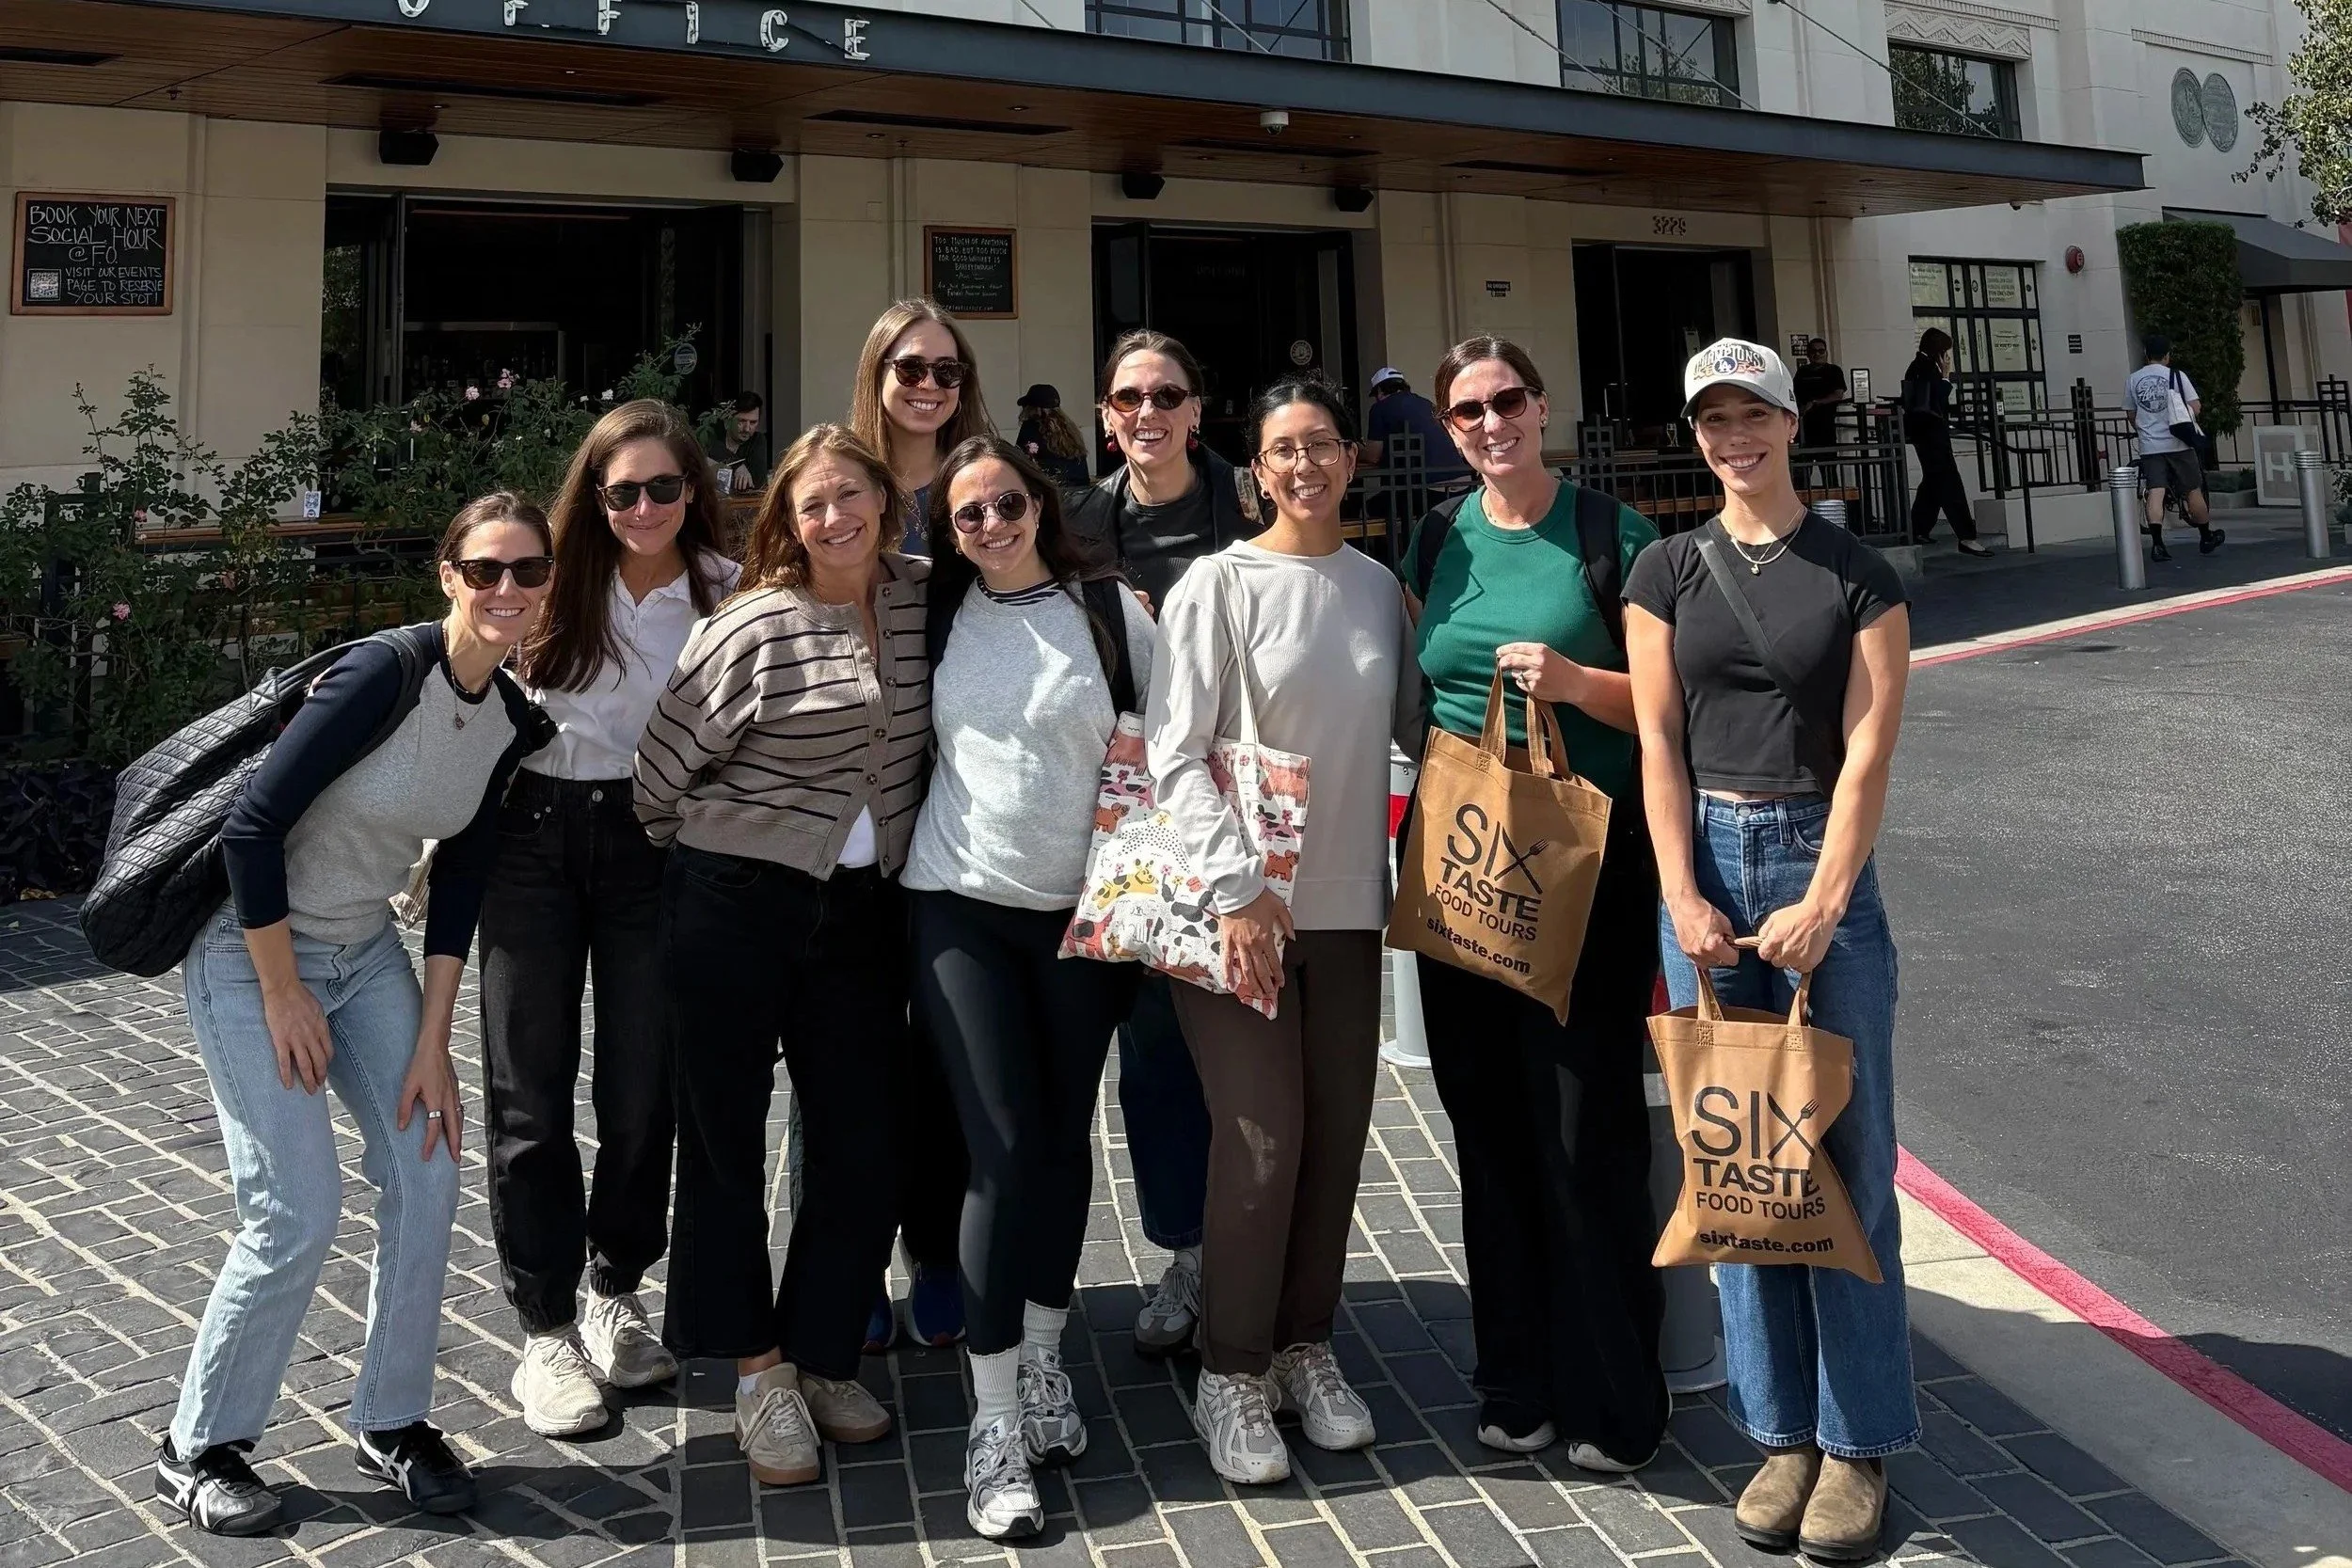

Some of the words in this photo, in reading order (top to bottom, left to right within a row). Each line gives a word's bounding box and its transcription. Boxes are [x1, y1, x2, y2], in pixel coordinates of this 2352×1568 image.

[30, 205, 77, 225] BOOK
[88, 204, 120, 227] YOUR
[126, 207, 165, 229] NEXT
[28, 226, 108, 245] SOCIAL
[112, 227, 164, 250] HOUR
[69, 246, 88, 261] @
[66, 267, 94, 277] VISIT
[98, 267, 117, 277] OUR
[119, 267, 162, 277] EVENTS
[68, 280, 96, 292] PAGE
[102, 281, 116, 291] TO
[120, 280, 164, 292] RESERVE
[68, 293, 117, 304] YOUR
[120, 293, 158, 305] SPOT!
[1447, 803, 1549, 895] SIX
[1440, 856, 1543, 924] TASTE
[1434, 884, 1472, 918] FOOD
[1478, 908, 1537, 942] TOURS
[1427, 916, 1531, 974] sixtaste.com
[1691, 1085, 1820, 1161] SIX
[1693, 1157, 1820, 1198] TASTE
[1696, 1192, 1754, 1214] FOOD
[1758, 1196, 1826, 1220] TOURS
[1699, 1230, 1834, 1253] sixtaste.com
